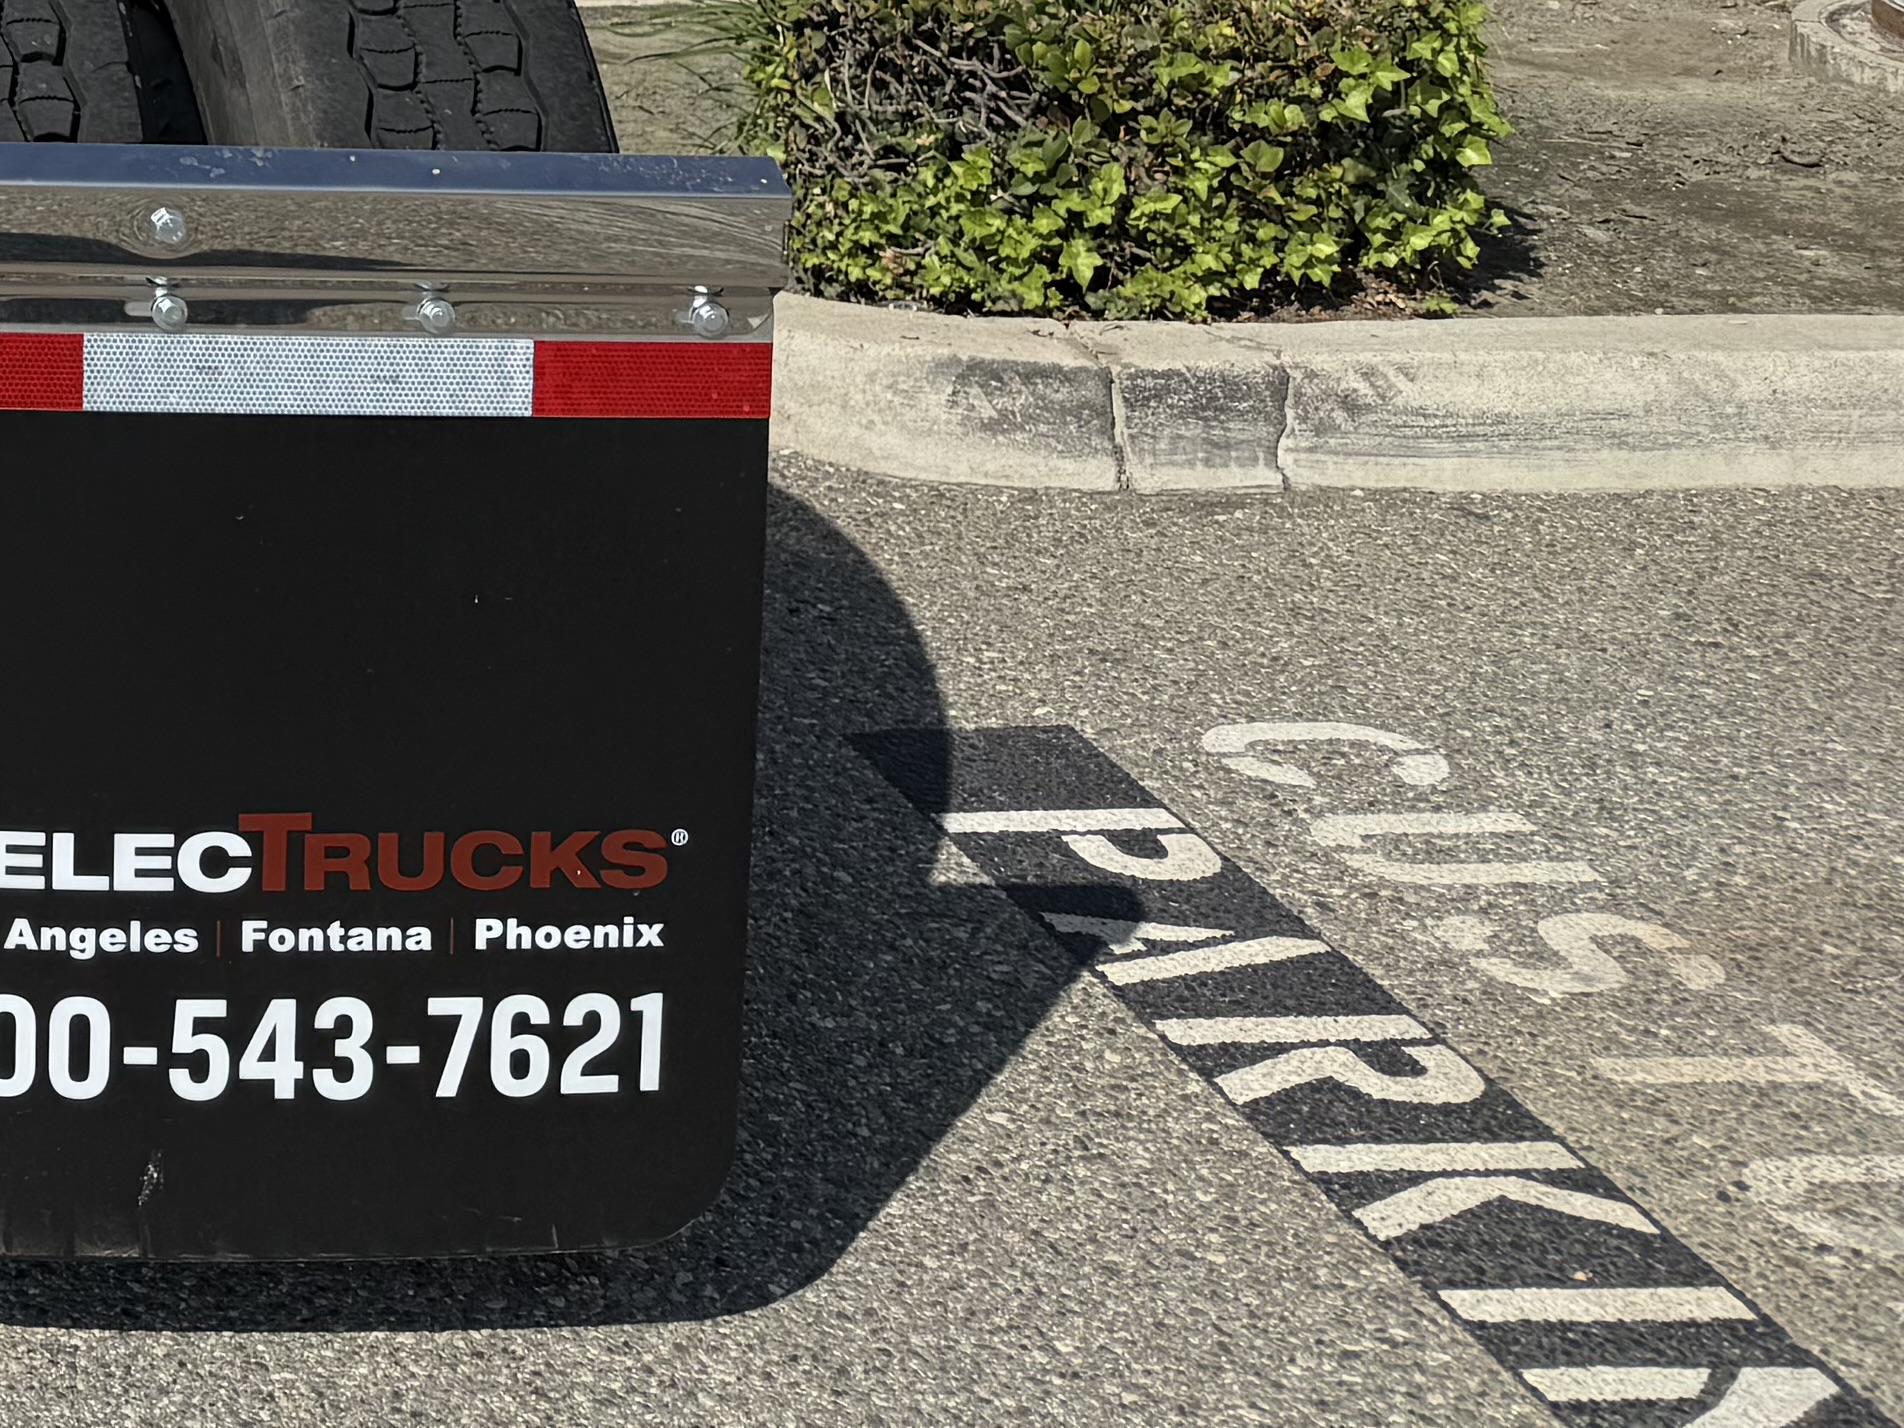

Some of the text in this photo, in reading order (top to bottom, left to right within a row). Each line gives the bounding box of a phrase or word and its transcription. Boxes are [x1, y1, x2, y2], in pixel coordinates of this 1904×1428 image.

[3, 917, 199, 960] Angeles
[241, 920, 432, 953] Fontana
[474, 916, 665, 951] Phoenix
